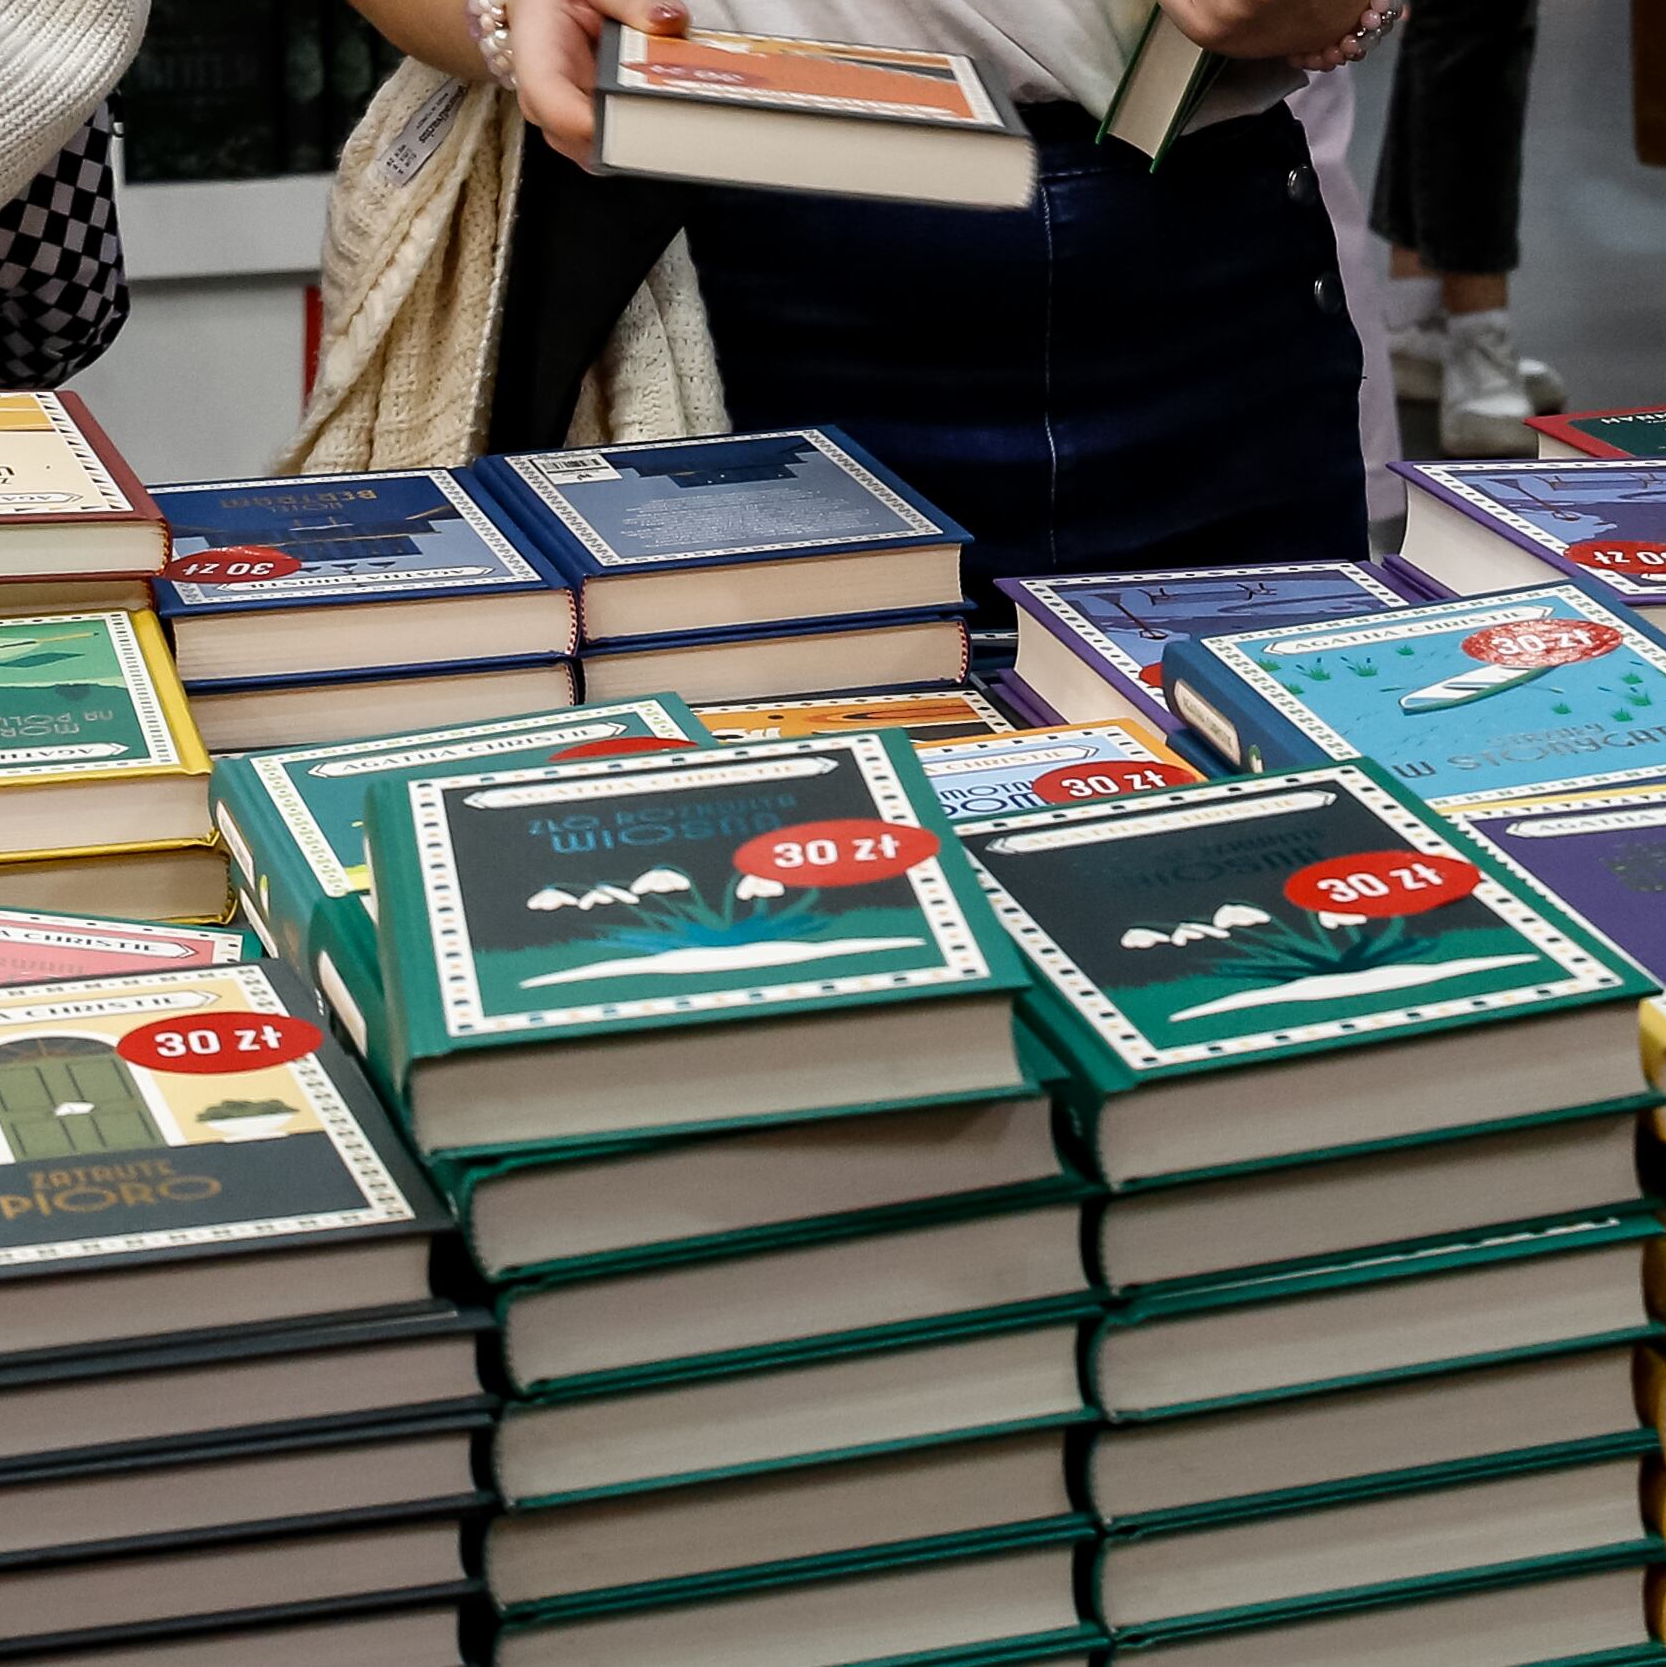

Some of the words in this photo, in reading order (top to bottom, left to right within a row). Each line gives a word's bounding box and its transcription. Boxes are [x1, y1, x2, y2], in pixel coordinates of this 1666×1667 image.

[182, 562, 220, 576] zł
[224, 562, 276, 576] 30
[1594, 550, 1631, 565] zł
[249, 575, 359, 589] CHRISTIE
[366, 567, 466, 581] AGATHA
[1294, 626, 1400, 651] AGATHA
[1407, 609, 1525, 637] CHRISTIE
[1490, 631, 1544, 656] 30
[1556, 625, 1597, 650] zł
[83, 709, 115, 722] NA
[342, 743, 464, 773] AGATHA
[467, 726, 594, 756] CHRISTIE
[945, 750, 1066, 774] CHRISTIE
[1391, 760, 1439, 780] W
[1060, 775, 1119, 799] 30
[1122, 770, 1168, 791] zł
[1537, 813, 1656, 834] AGATHA
[772, 837, 839, 870] 30
[852, 836, 902, 864] zł
[1315, 871, 1388, 904] 30
[1390, 861, 1446, 892] zł
[23, 931, 160, 954] CHRISTIE
[25, 990, 181, 1024] CHRISTIE
[154, 1028, 221, 1059] 30
[233, 1024, 284, 1053] zł
[27, 1158, 176, 1188] ZATRUTE
